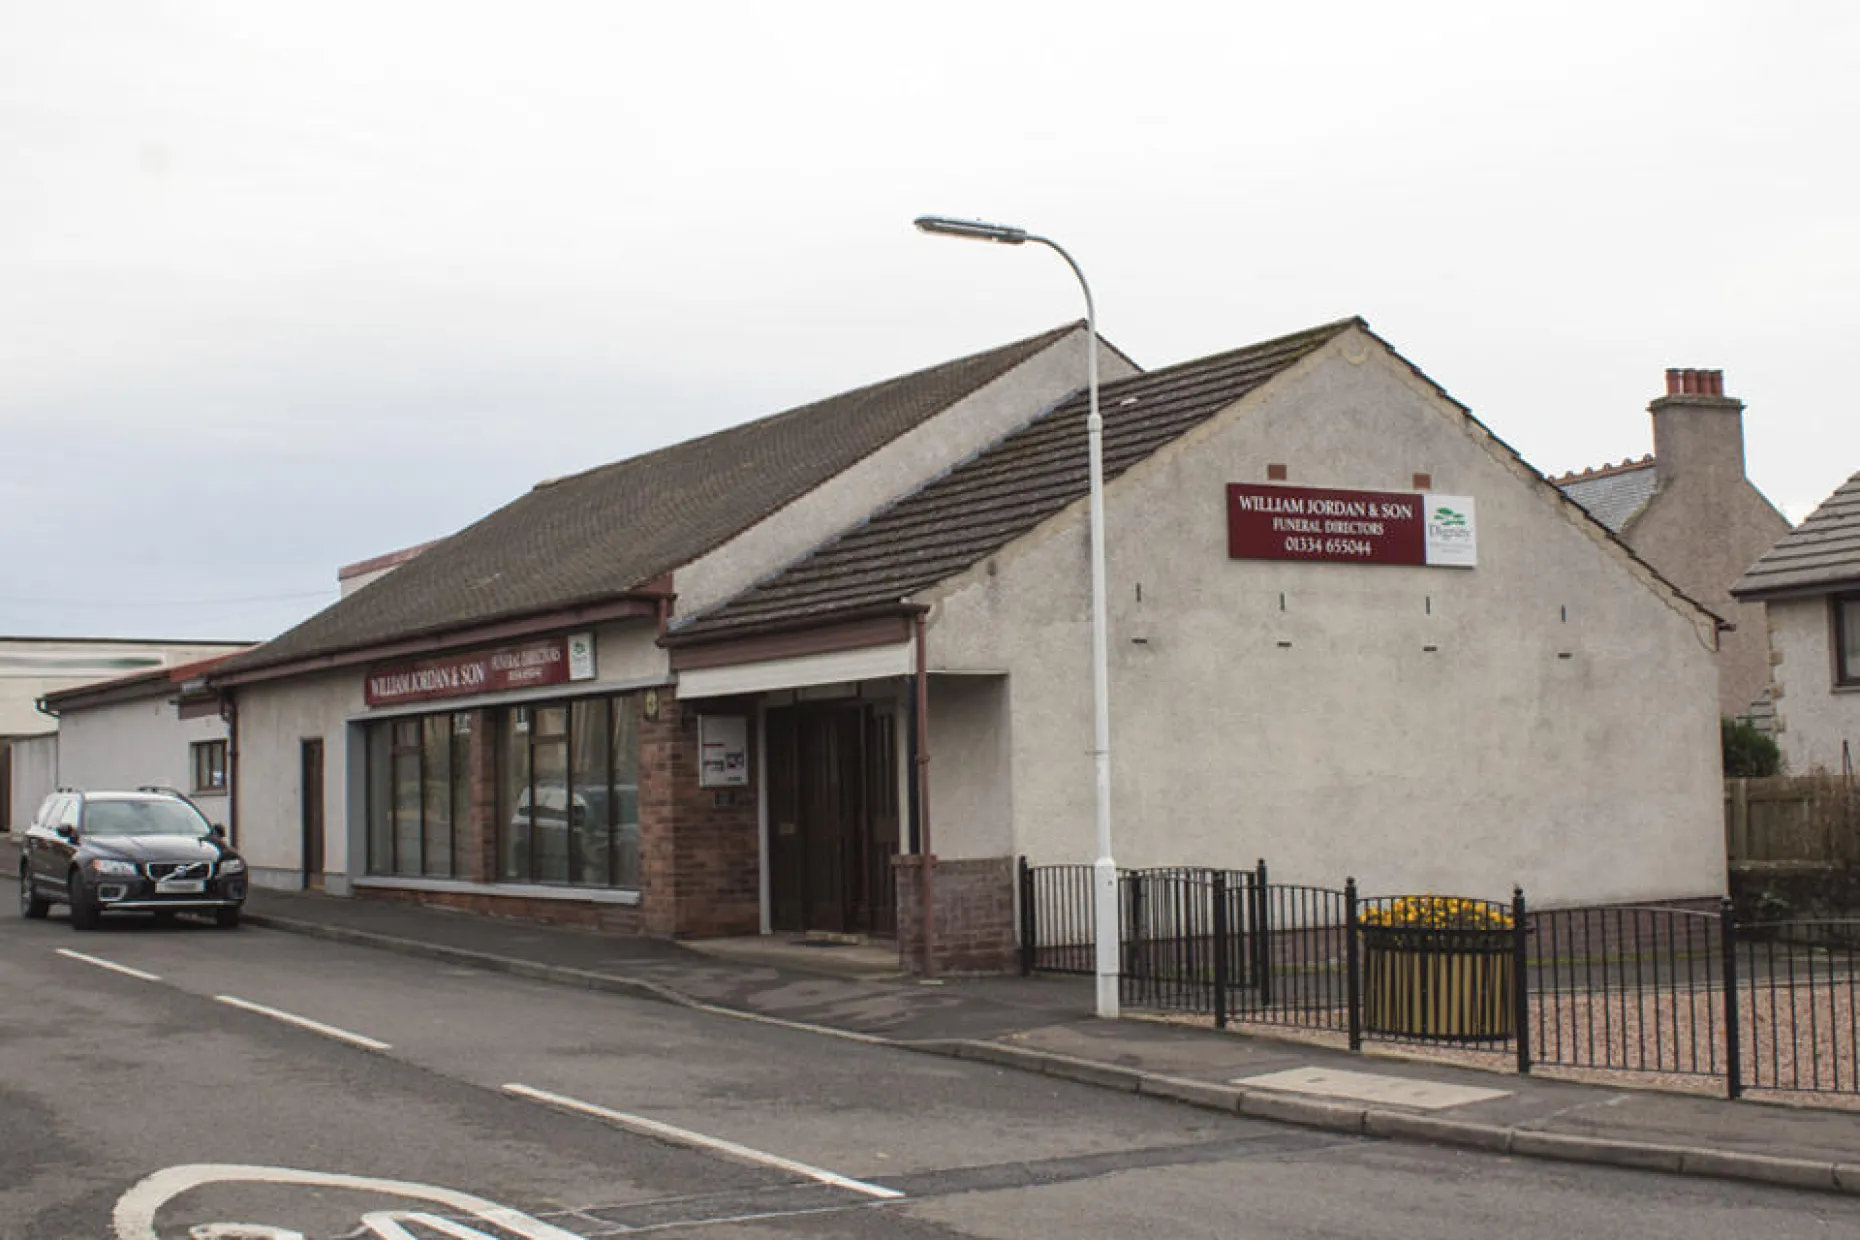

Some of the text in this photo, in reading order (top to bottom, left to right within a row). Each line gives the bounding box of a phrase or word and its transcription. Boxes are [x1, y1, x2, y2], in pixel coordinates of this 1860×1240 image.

[1239, 495, 1413, 519] WILLIAM JORDAN & SON
[1272, 516, 1384, 536] FUNERAL DIRECTORS
[1285, 536, 1371, 557] 01334 655044
[371, 673, 409, 697] WILLIAM
[410, 667, 449, 692] JORDAN
[461, 661, 485, 684] SON
